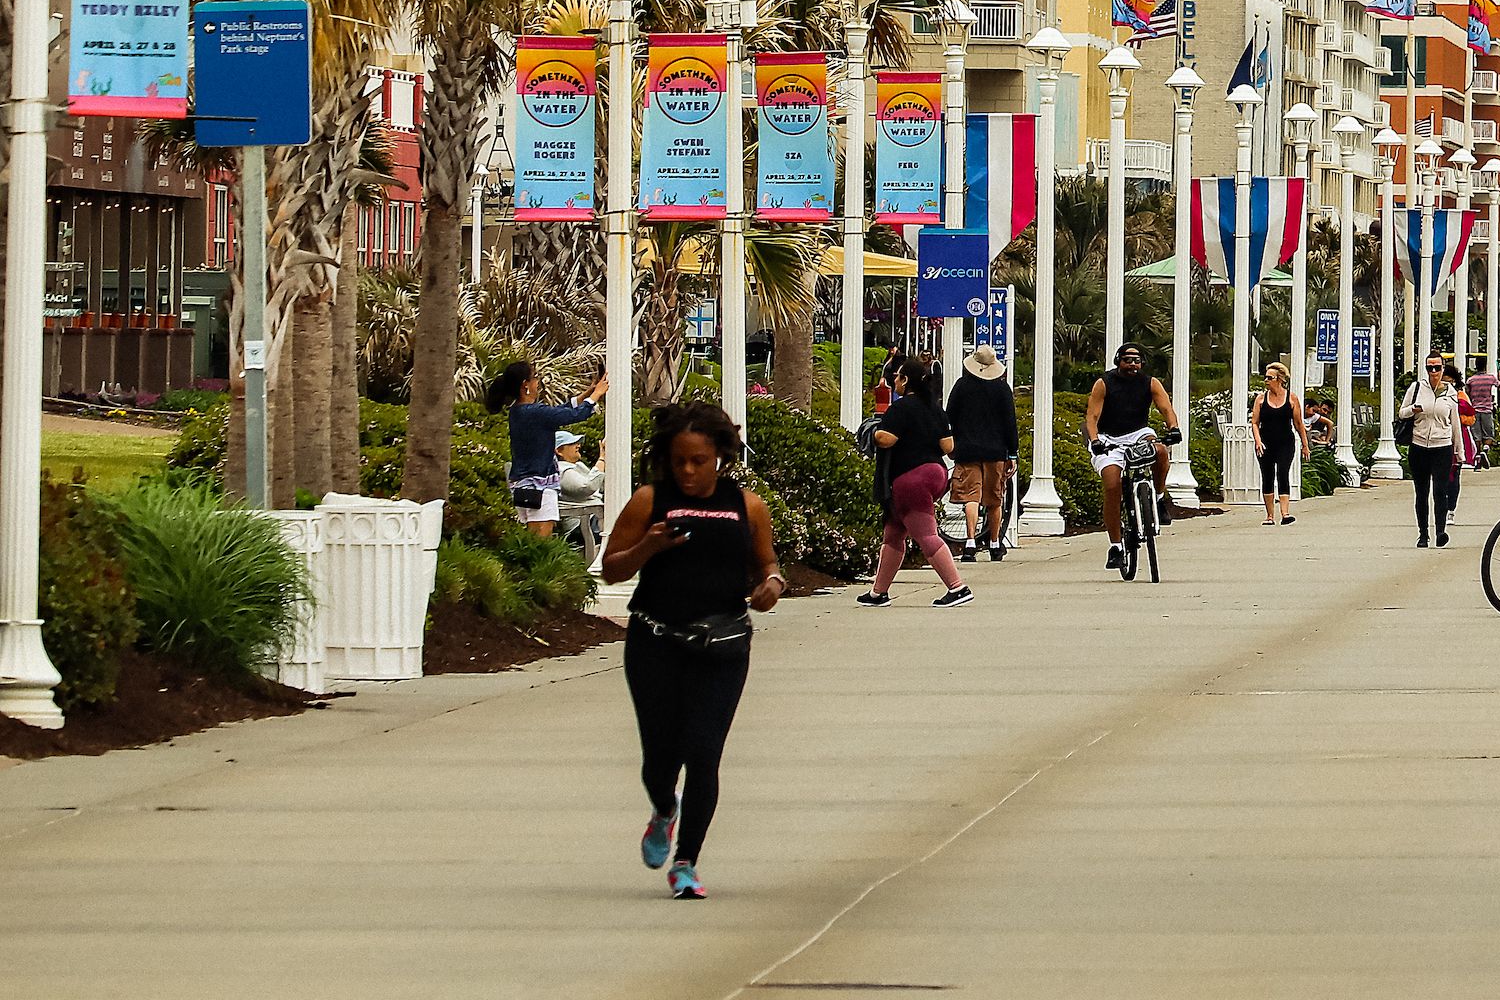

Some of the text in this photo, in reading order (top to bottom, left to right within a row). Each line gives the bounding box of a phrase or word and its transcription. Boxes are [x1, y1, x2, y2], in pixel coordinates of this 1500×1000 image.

[81, 4, 180, 17] TEDDY RILEY
[220, 22, 303, 31] Public Restrooms
[220, 32, 305, 44] behind Neptune's
[83, 41, 115, 49] APRIL
[136, 42, 149, 50] 27
[220, 44, 269, 55] Park stage
[526, 73, 585, 92] SOMETHING
[659, 70, 718, 89] SOMETHING
[536, 91, 576, 99] IN THE
[669, 88, 709, 96] IN THE
[766, 85, 818, 103] SOMETHING
[533, 105, 577, 114] WATER
[666, 102, 709, 111] WATER
[885, 102, 933, 118] SOMETHING
[773, 115, 811, 123] WATER
[534, 142, 576, 150] MAGGIE
[534, 151, 575, 159] ROGERS
[44, 294, 68, 302] EACH
[1320, 312, 1337, 320] ONLY
